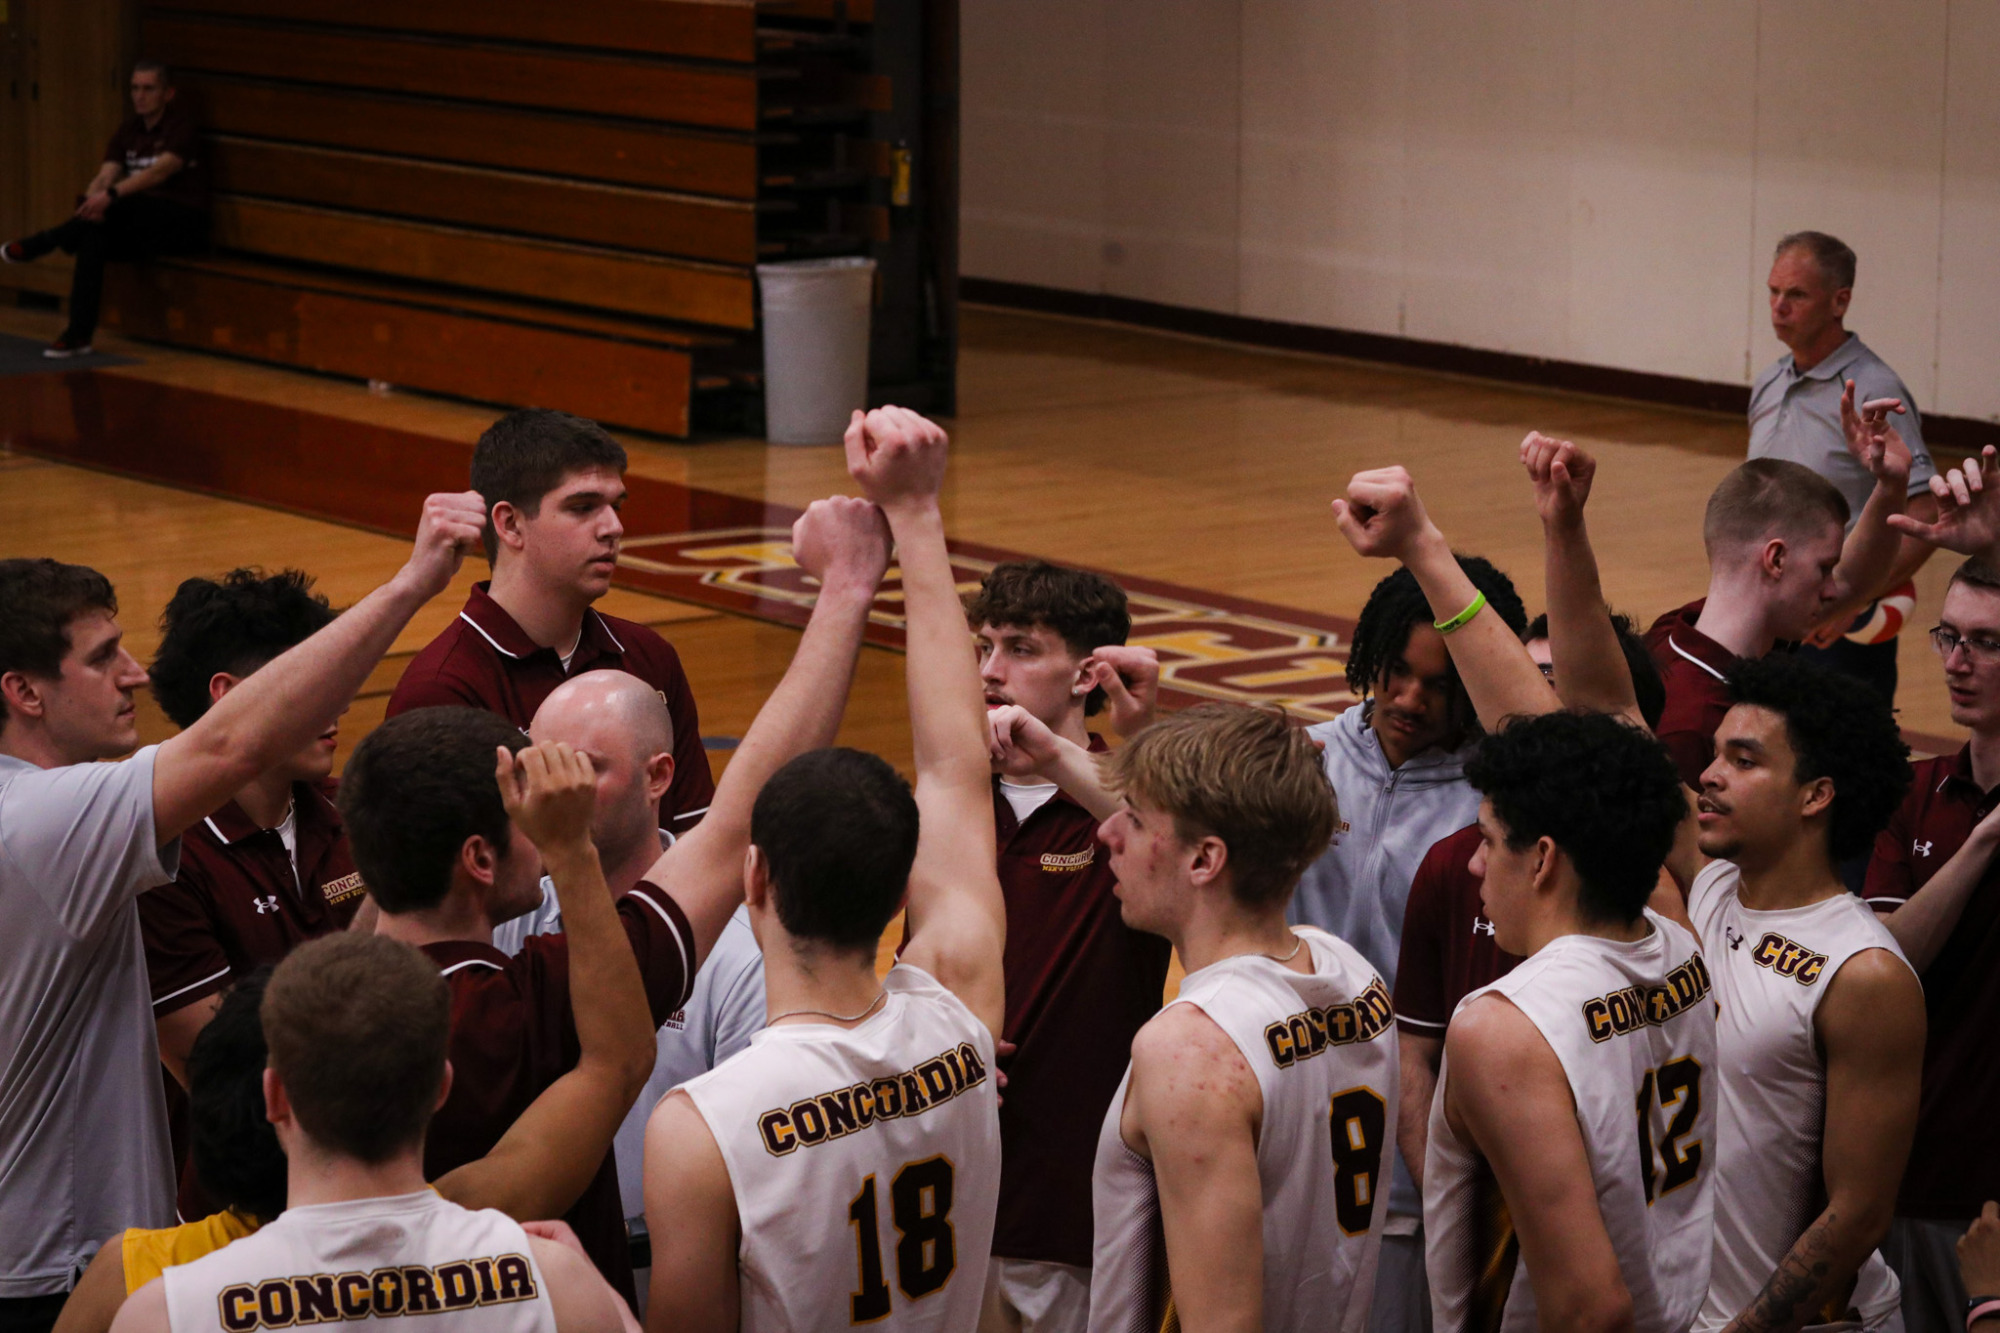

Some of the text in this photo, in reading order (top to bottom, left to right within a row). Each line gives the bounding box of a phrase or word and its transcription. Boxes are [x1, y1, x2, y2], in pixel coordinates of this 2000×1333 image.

[1752, 932, 1829, 987] CUC
[756, 1042, 987, 1157] CONCORDIA
[1329, 1085, 1387, 1238] 8
[1636, 1054, 1703, 1208] 12
[217, 1253, 538, 1333] CONCORDIA
[848, 1153, 957, 1327] 18
